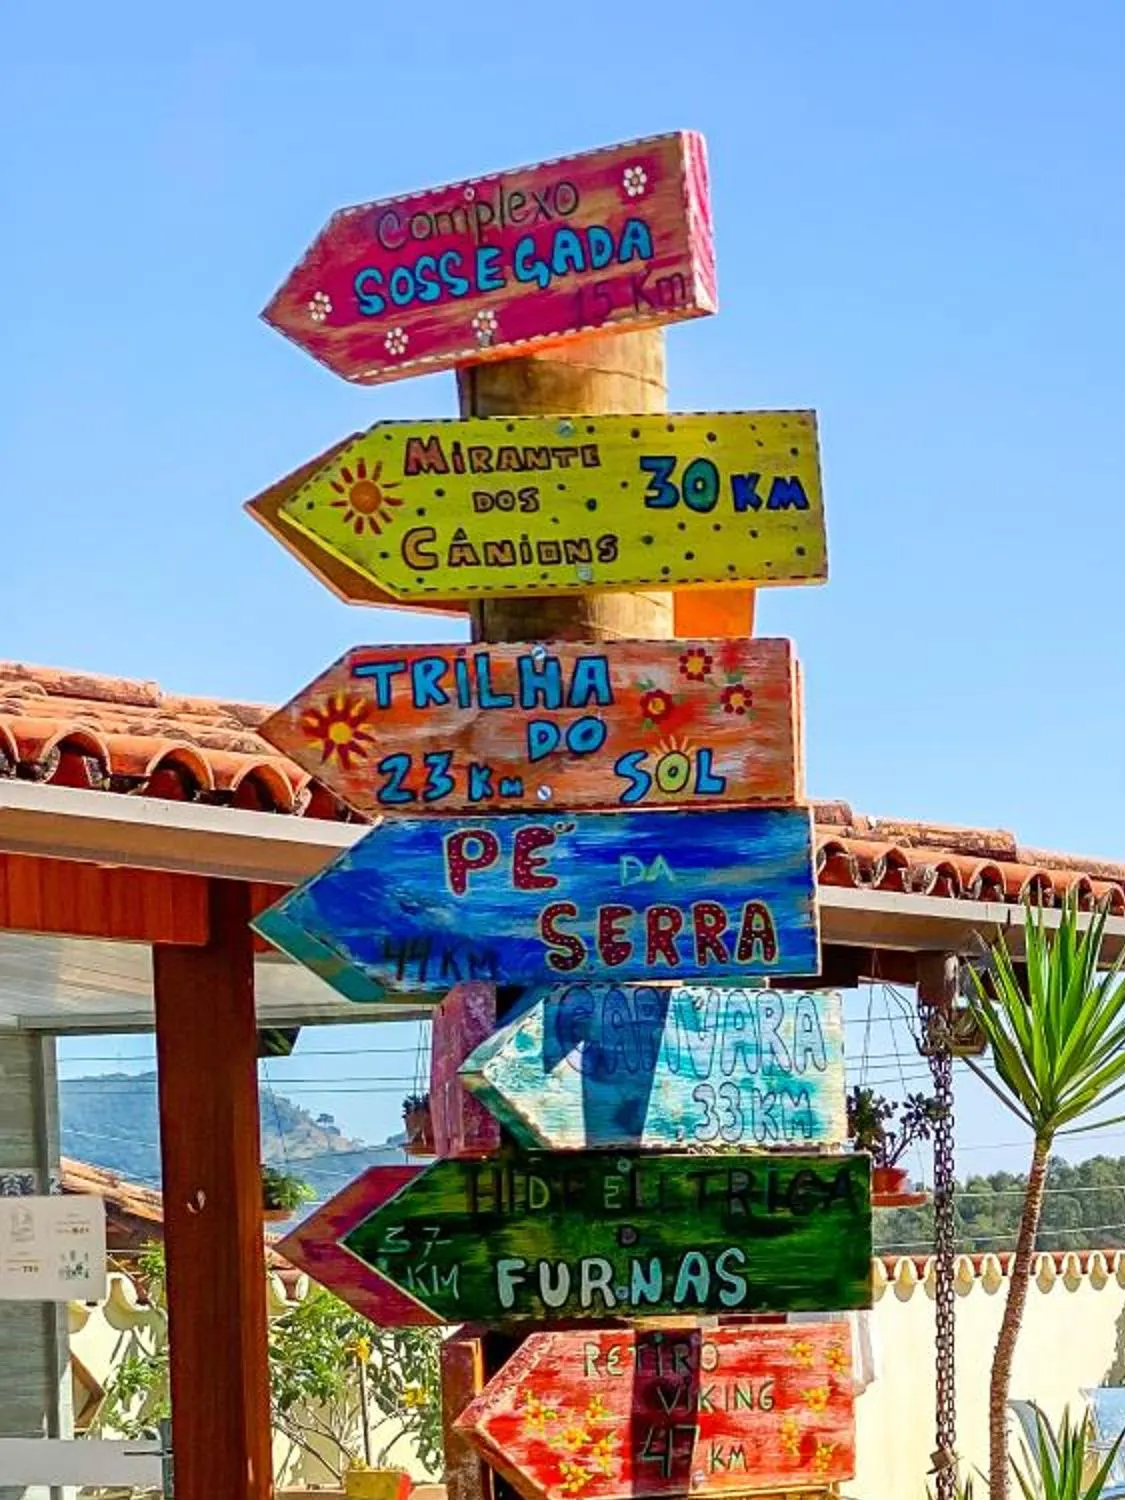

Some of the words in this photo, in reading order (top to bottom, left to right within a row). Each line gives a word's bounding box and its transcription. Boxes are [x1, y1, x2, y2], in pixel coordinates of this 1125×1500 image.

[376, 181, 580, 249] Complexo
[354, 218, 654, 316] SOSSEGADA
[472, 486, 540, 513] DOS
[639, 456, 720, 512] 30
[527, 715, 607, 762] DO
[377, 750, 456, 804] 23
[613, 747, 727, 803] SOL
[444, 820, 576, 897] PÉ
[620, 853, 677, 887] DA
[538, 900, 780, 972] SERRA
[498, 1246, 749, 1309] FURNAS
[656, 1380, 775, 1415] VIKING
[640, 1424, 701, 1479] 47
[708, 1441, 749, 1473] KM
